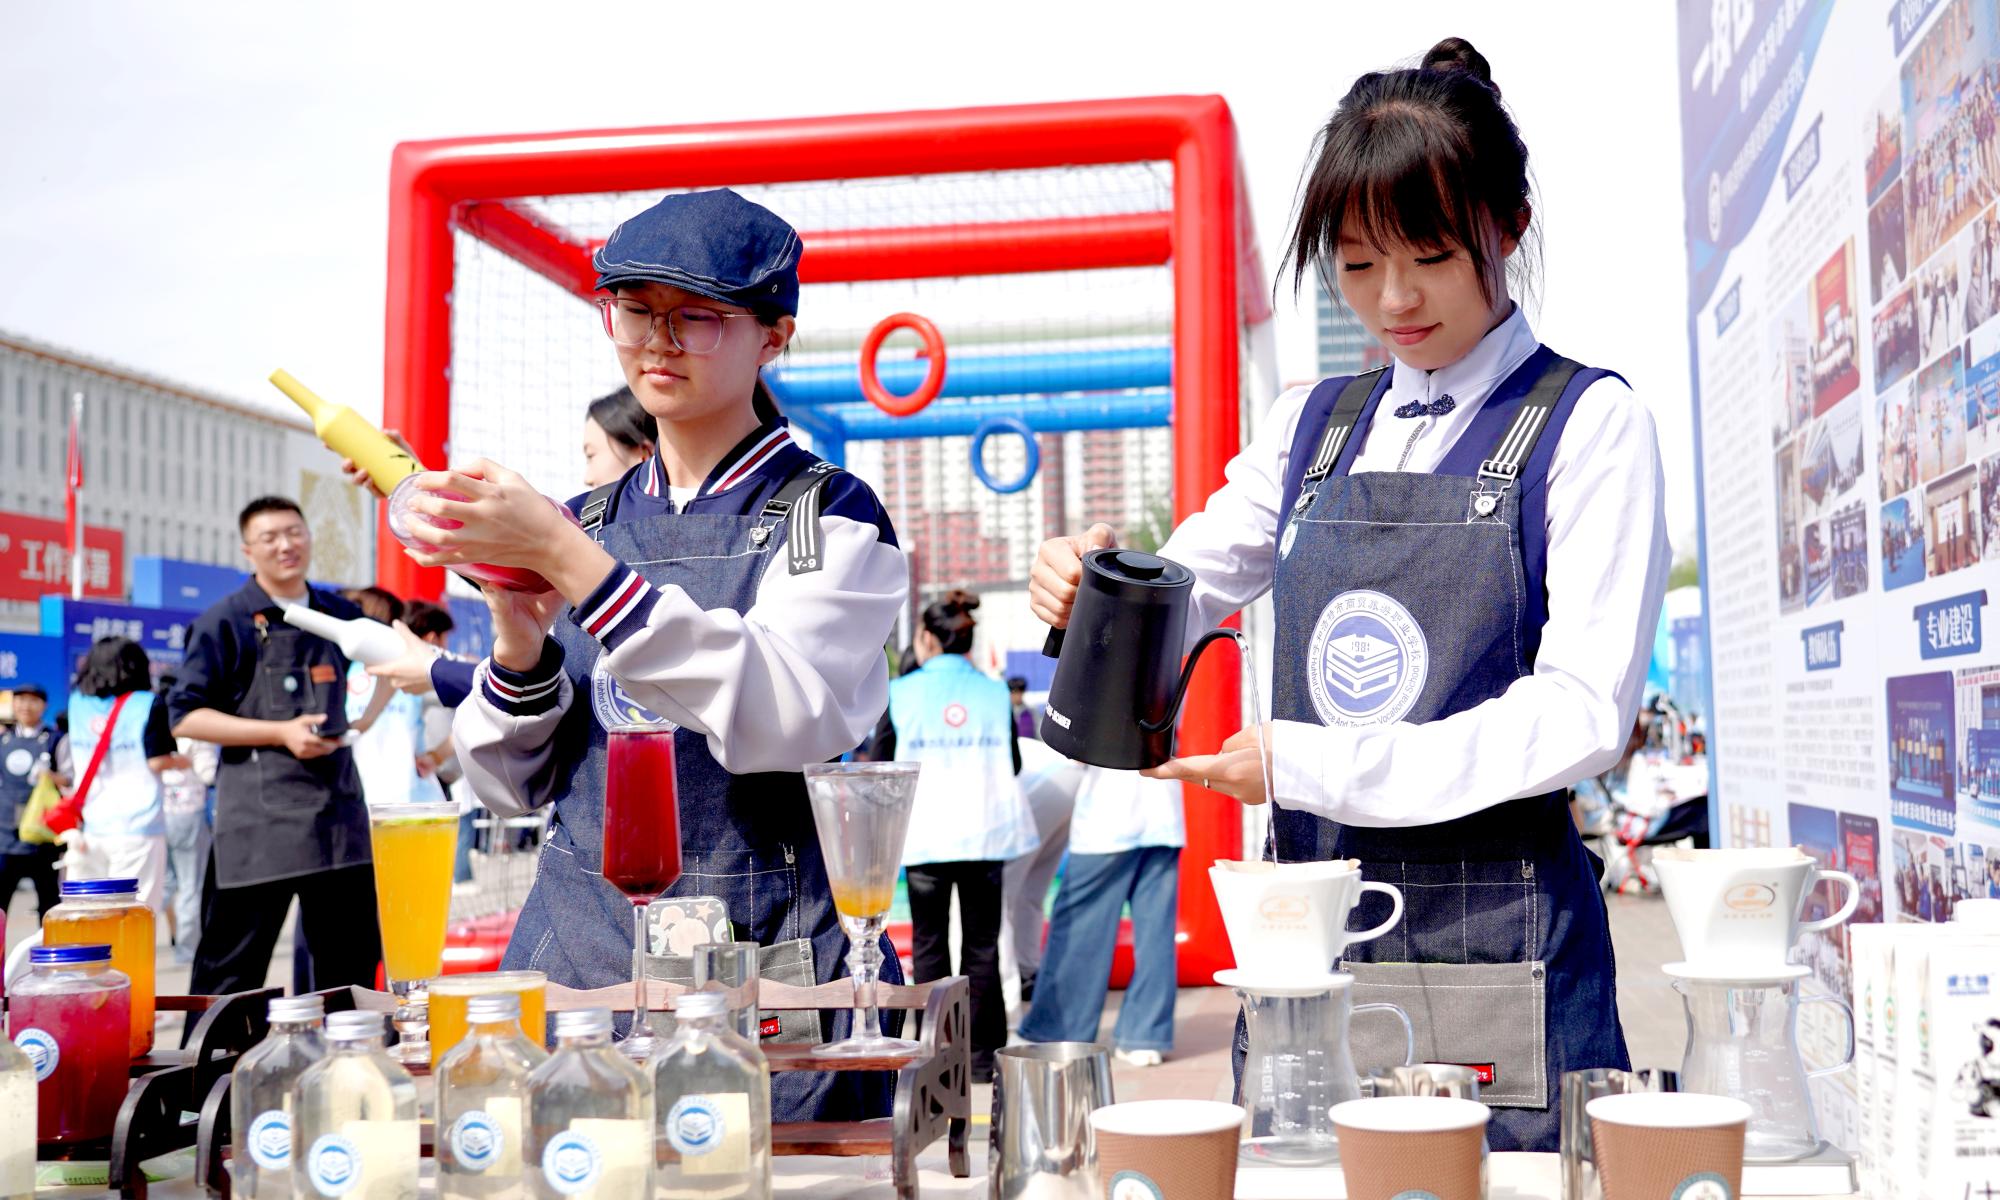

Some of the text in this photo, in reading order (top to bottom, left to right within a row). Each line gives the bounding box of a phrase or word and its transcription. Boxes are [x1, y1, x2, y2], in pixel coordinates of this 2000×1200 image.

[792, 558, 817, 570] Y-9
[1926, 604, 1974, 650] 专业建设
[1314, 687, 1336, 723] Commerce
[1377, 693, 1410, 724] Vocational
[1405, 665, 1420, 693] School
[600, 705, 618, 728] Comm
